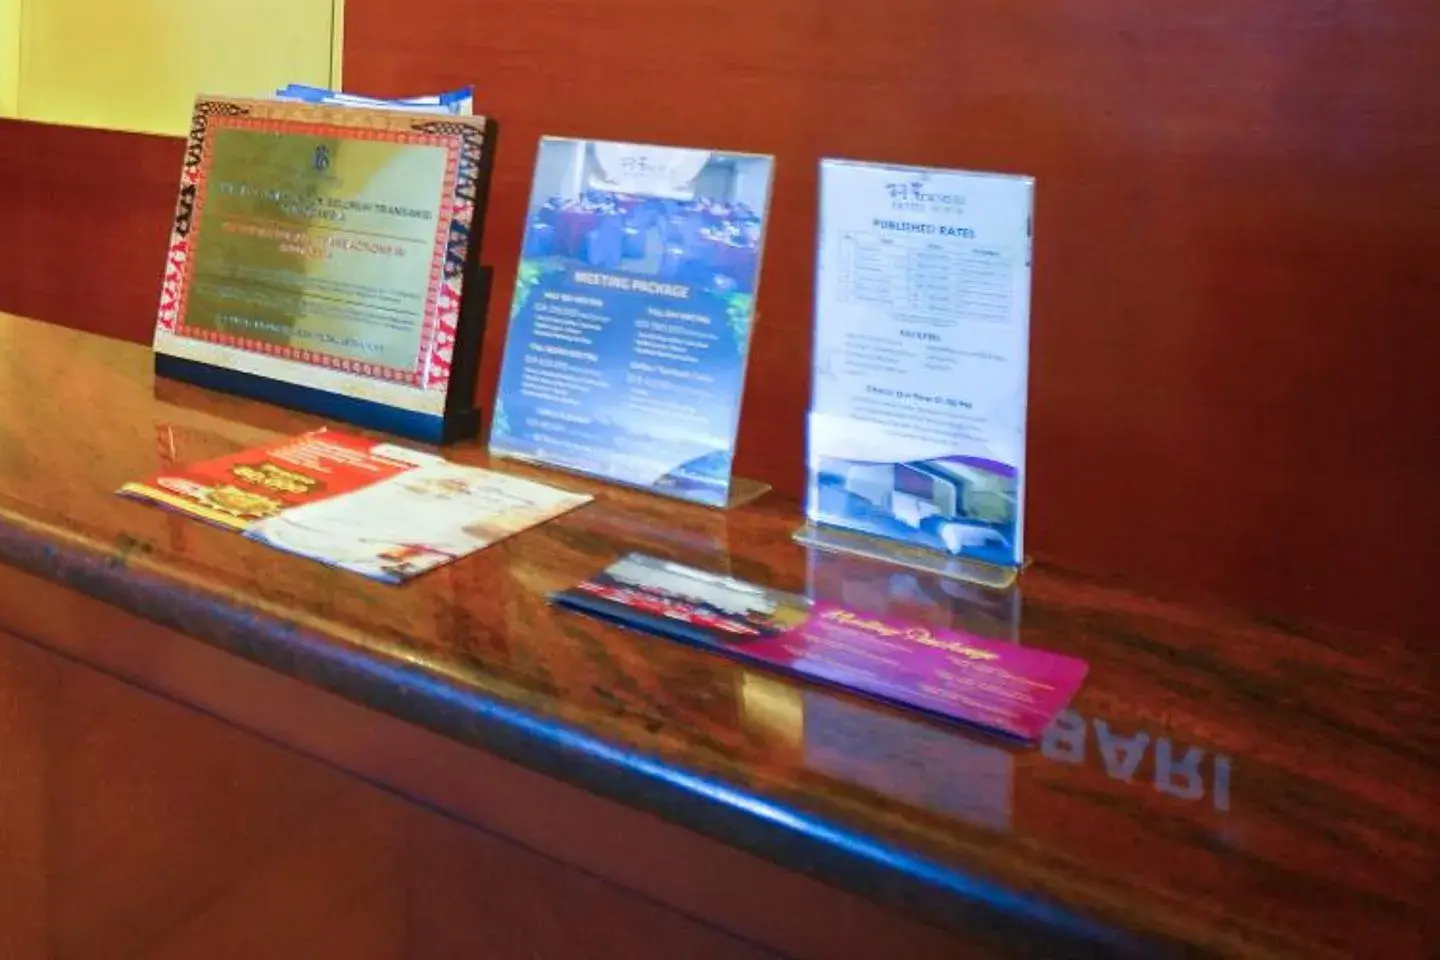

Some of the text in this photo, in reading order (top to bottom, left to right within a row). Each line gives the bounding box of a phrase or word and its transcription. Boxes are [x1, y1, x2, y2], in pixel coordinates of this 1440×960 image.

[872, 218, 976, 239] PUBLISHED RATES
[574, 271, 691, 299] MEETING PACKAGE
